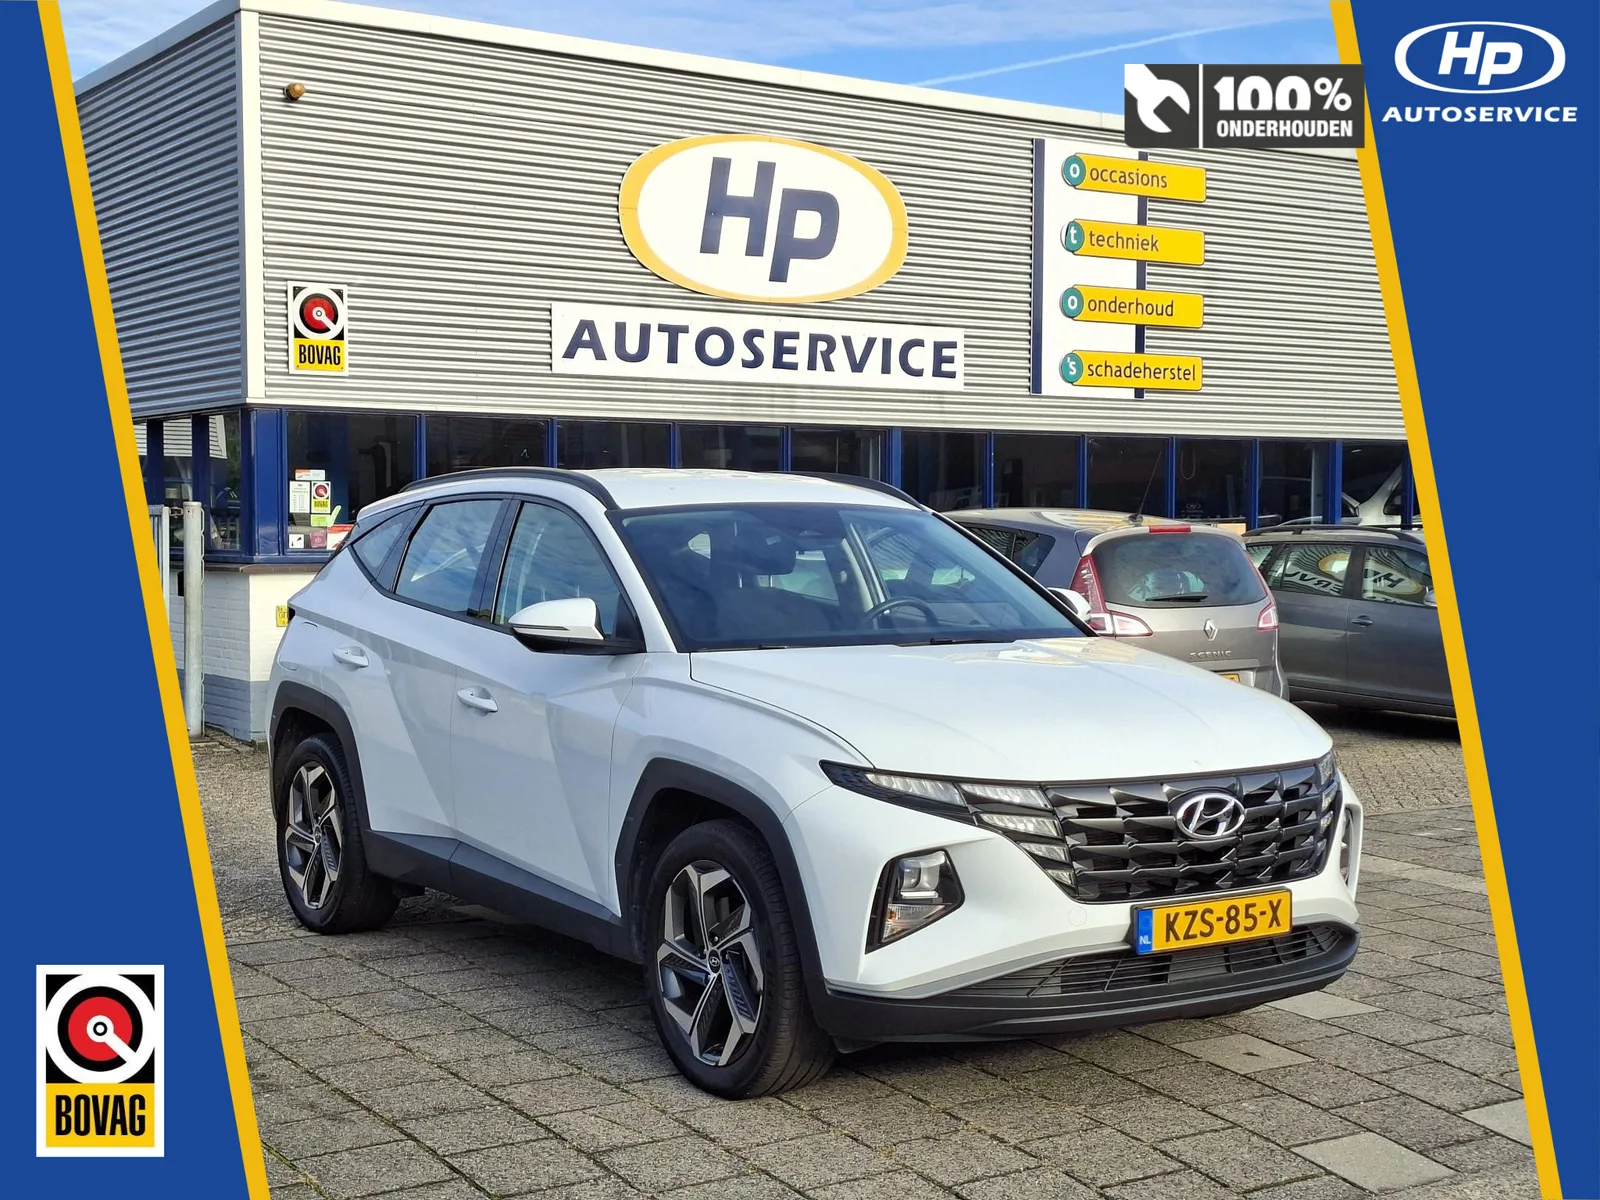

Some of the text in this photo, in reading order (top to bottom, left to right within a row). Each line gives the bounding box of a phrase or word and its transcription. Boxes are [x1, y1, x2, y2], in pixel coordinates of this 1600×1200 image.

[1089, 167, 1168, 188] occasions
[1089, 230, 1159, 252] techniek
[1087, 296, 1174, 316] onderhoud
[298, 344, 341, 365] BOVAG
[562, 319, 958, 379] AUTOSERVICE
[1087, 360, 1196, 381] schadeherstel
[1189, 650, 1232, 660] SCENIC
[1139, 898, 1282, 944] NL KZS-85-X
